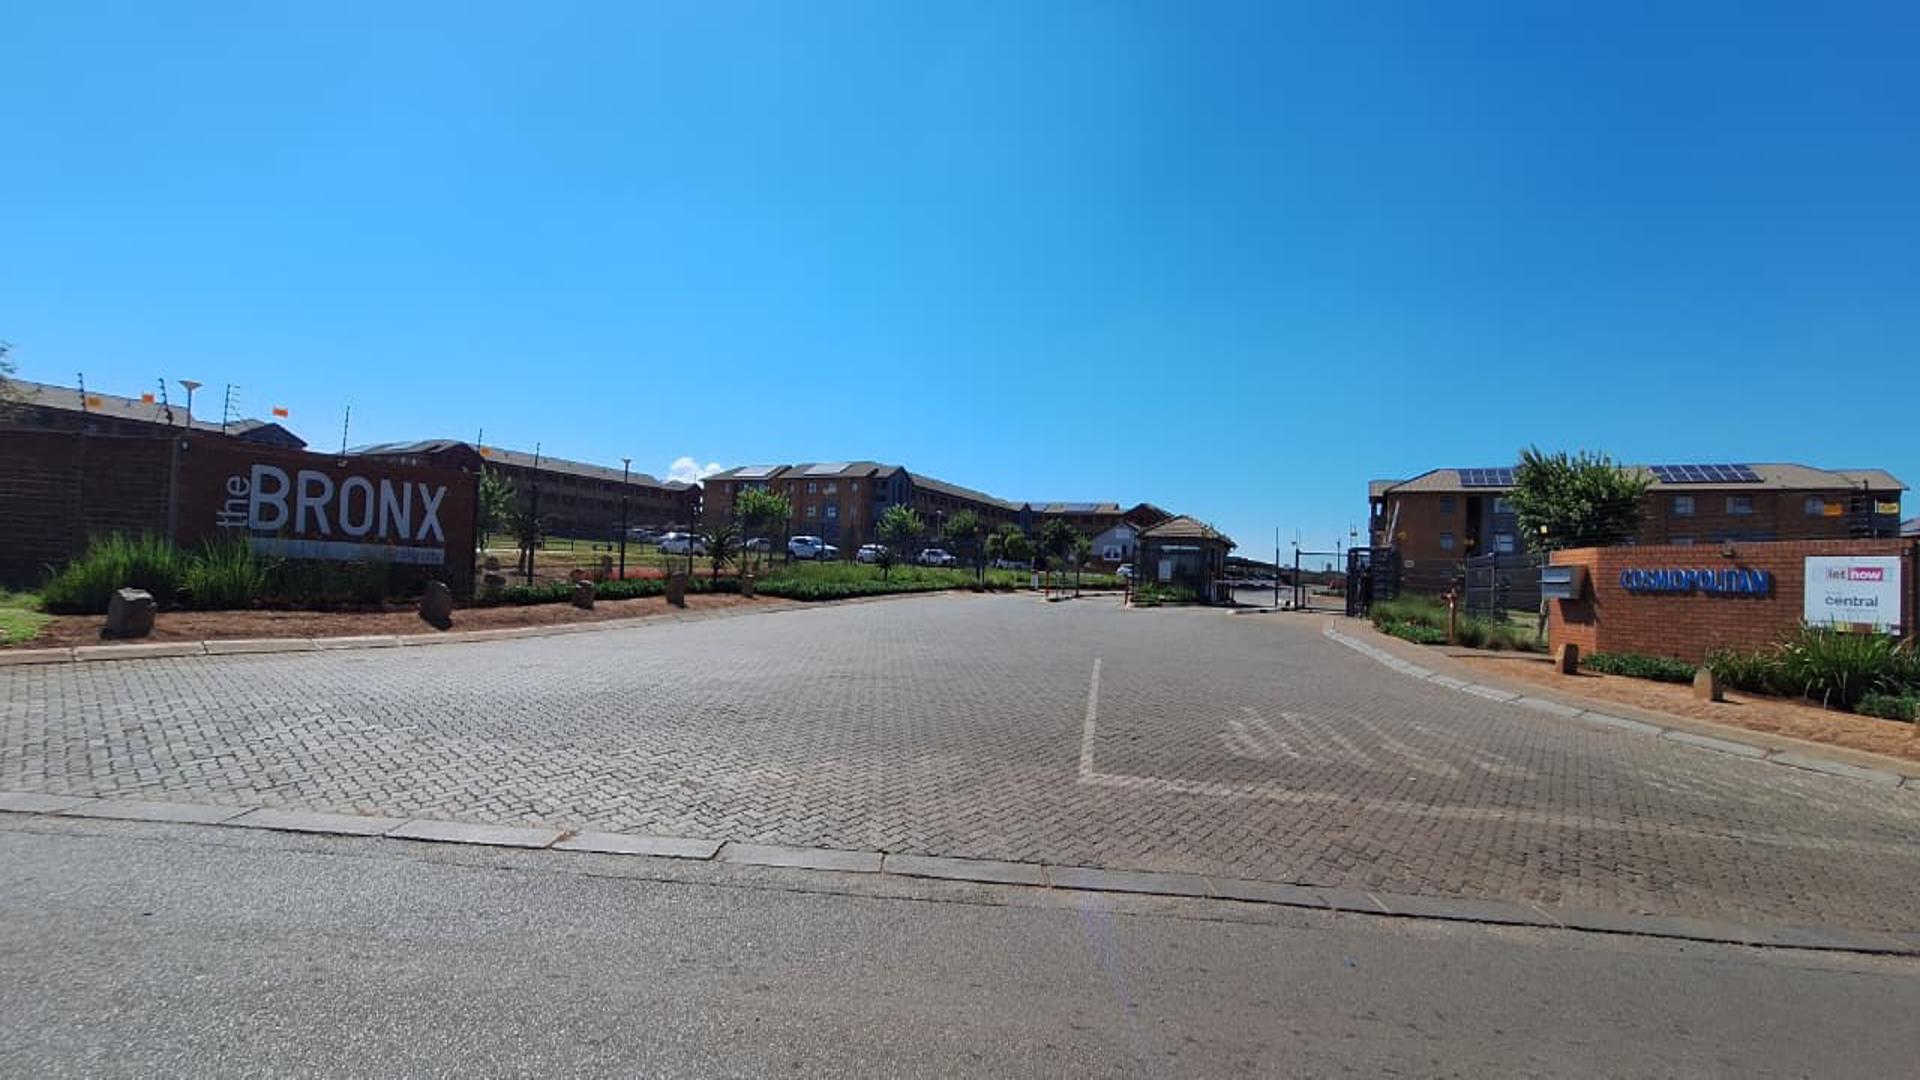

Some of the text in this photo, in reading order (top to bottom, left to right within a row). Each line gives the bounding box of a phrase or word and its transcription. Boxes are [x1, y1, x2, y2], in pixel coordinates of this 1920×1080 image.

[216, 464, 447, 542] the BRONX
[1620, 568, 1770, 593] COSMOPOLITAN
[1828, 568, 1881, 580] let now
[1825, 596, 1878, 607] central
